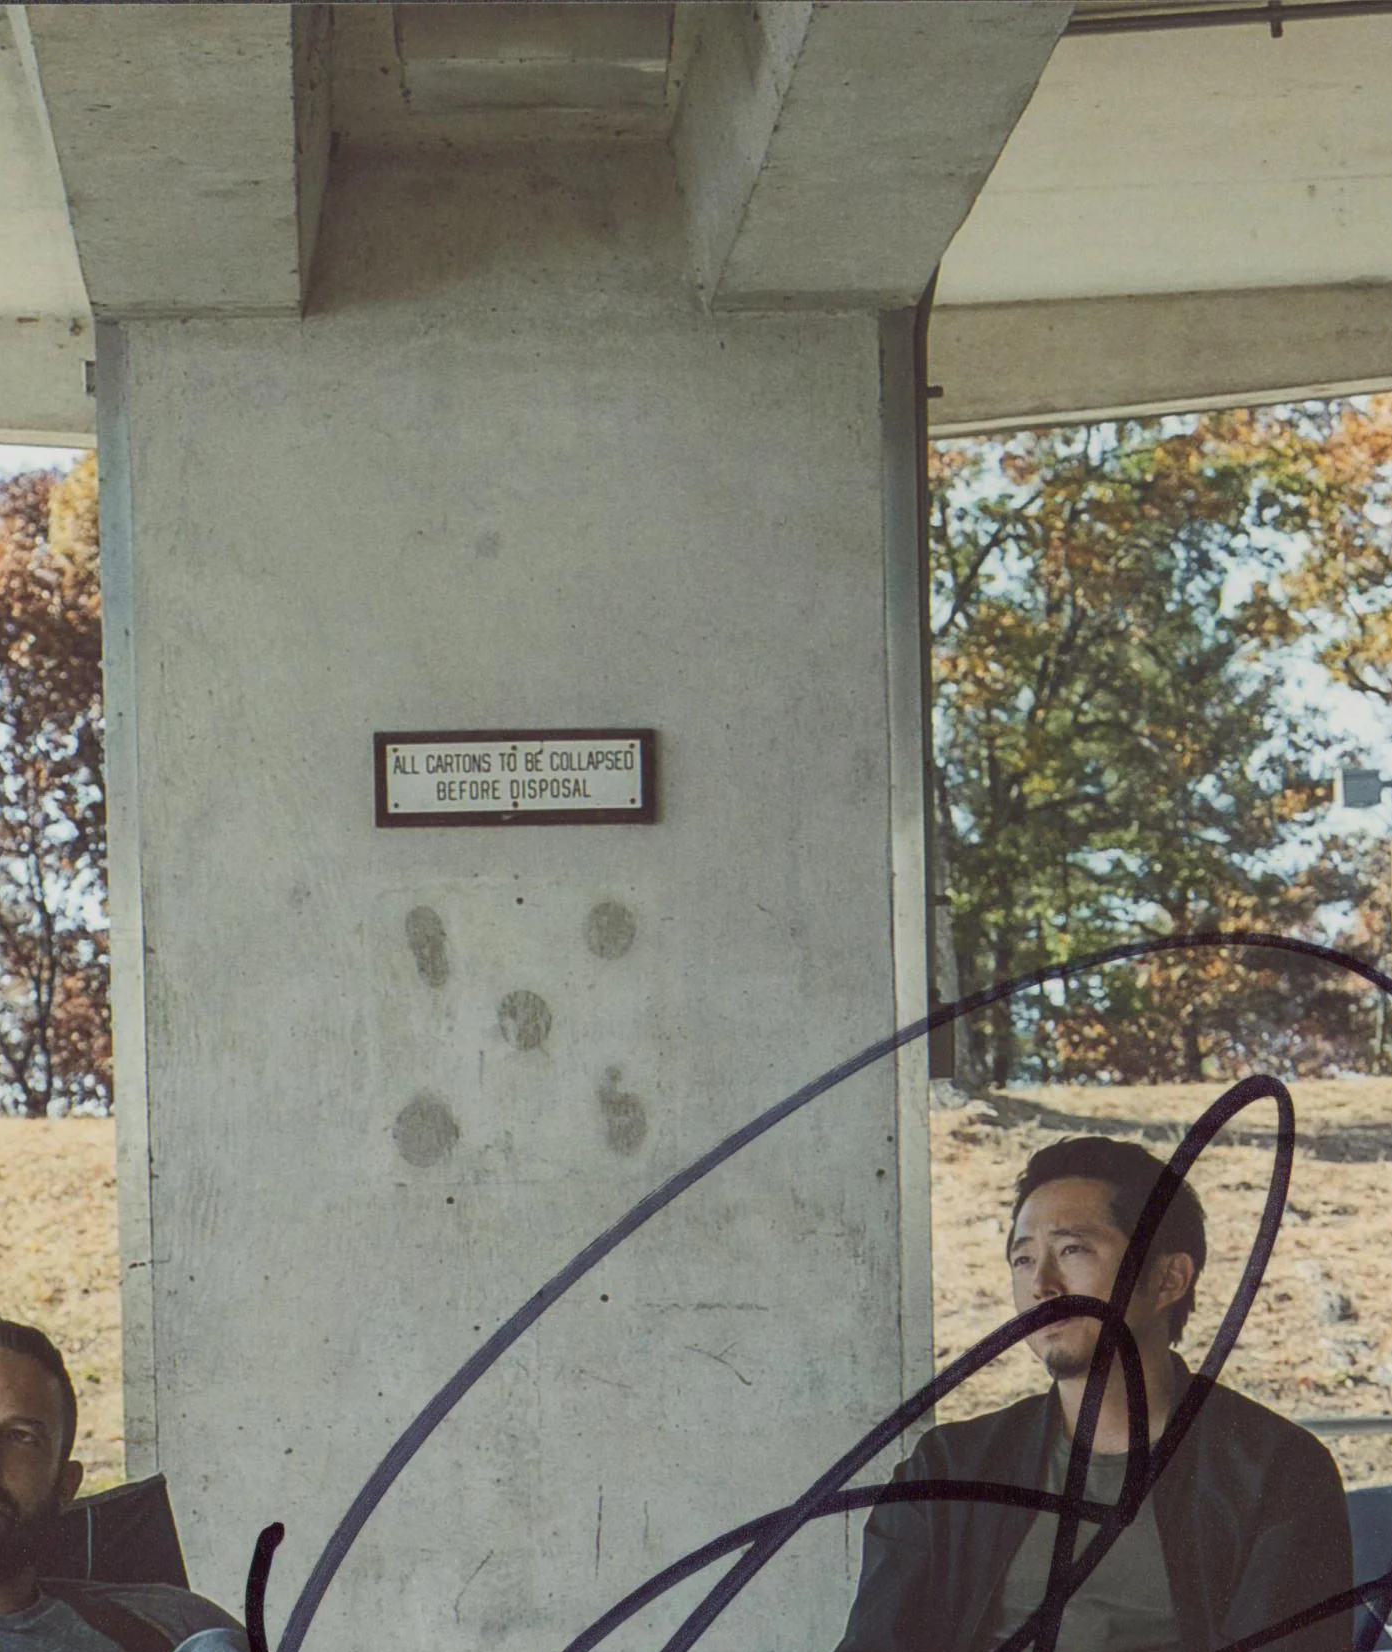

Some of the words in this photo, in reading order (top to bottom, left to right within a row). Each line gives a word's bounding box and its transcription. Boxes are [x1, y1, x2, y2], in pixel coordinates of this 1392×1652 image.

[392, 754, 420, 775] ALL
[425, 752, 492, 774] CARTONS
[498, 751, 518, 772] TO
[524, 751, 543, 772] BE
[549, 749, 635, 771] COLLAPSED
[436, 779, 502, 801] BEFORE
[509, 778, 592, 799] DISPOSAL
